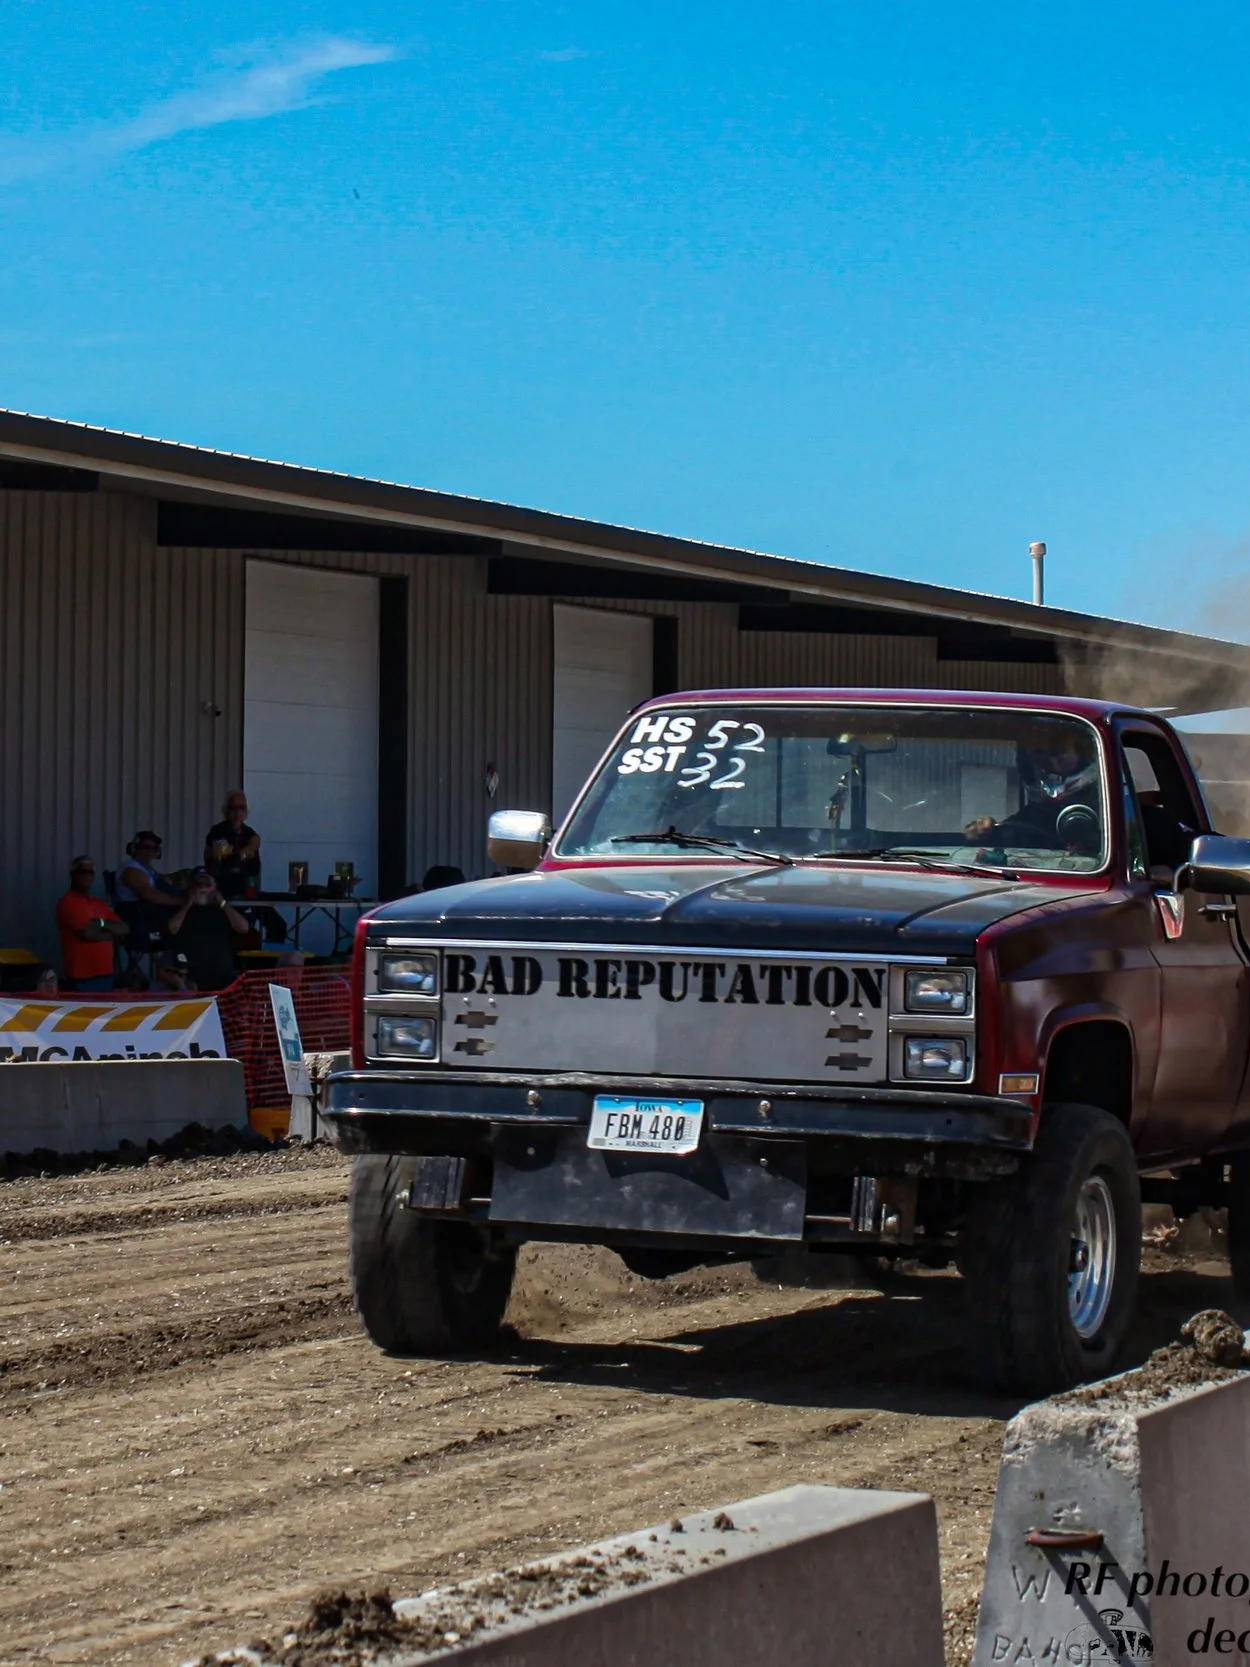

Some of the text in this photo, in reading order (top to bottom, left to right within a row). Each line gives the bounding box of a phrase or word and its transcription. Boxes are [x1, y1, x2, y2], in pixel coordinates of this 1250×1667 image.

[630, 716, 765, 752] HS 52
[617, 746, 745, 789] SST 32
[444, 954, 887, 1009] BAD REPUTATION
[604, 1113, 686, 1141] FBM 480
